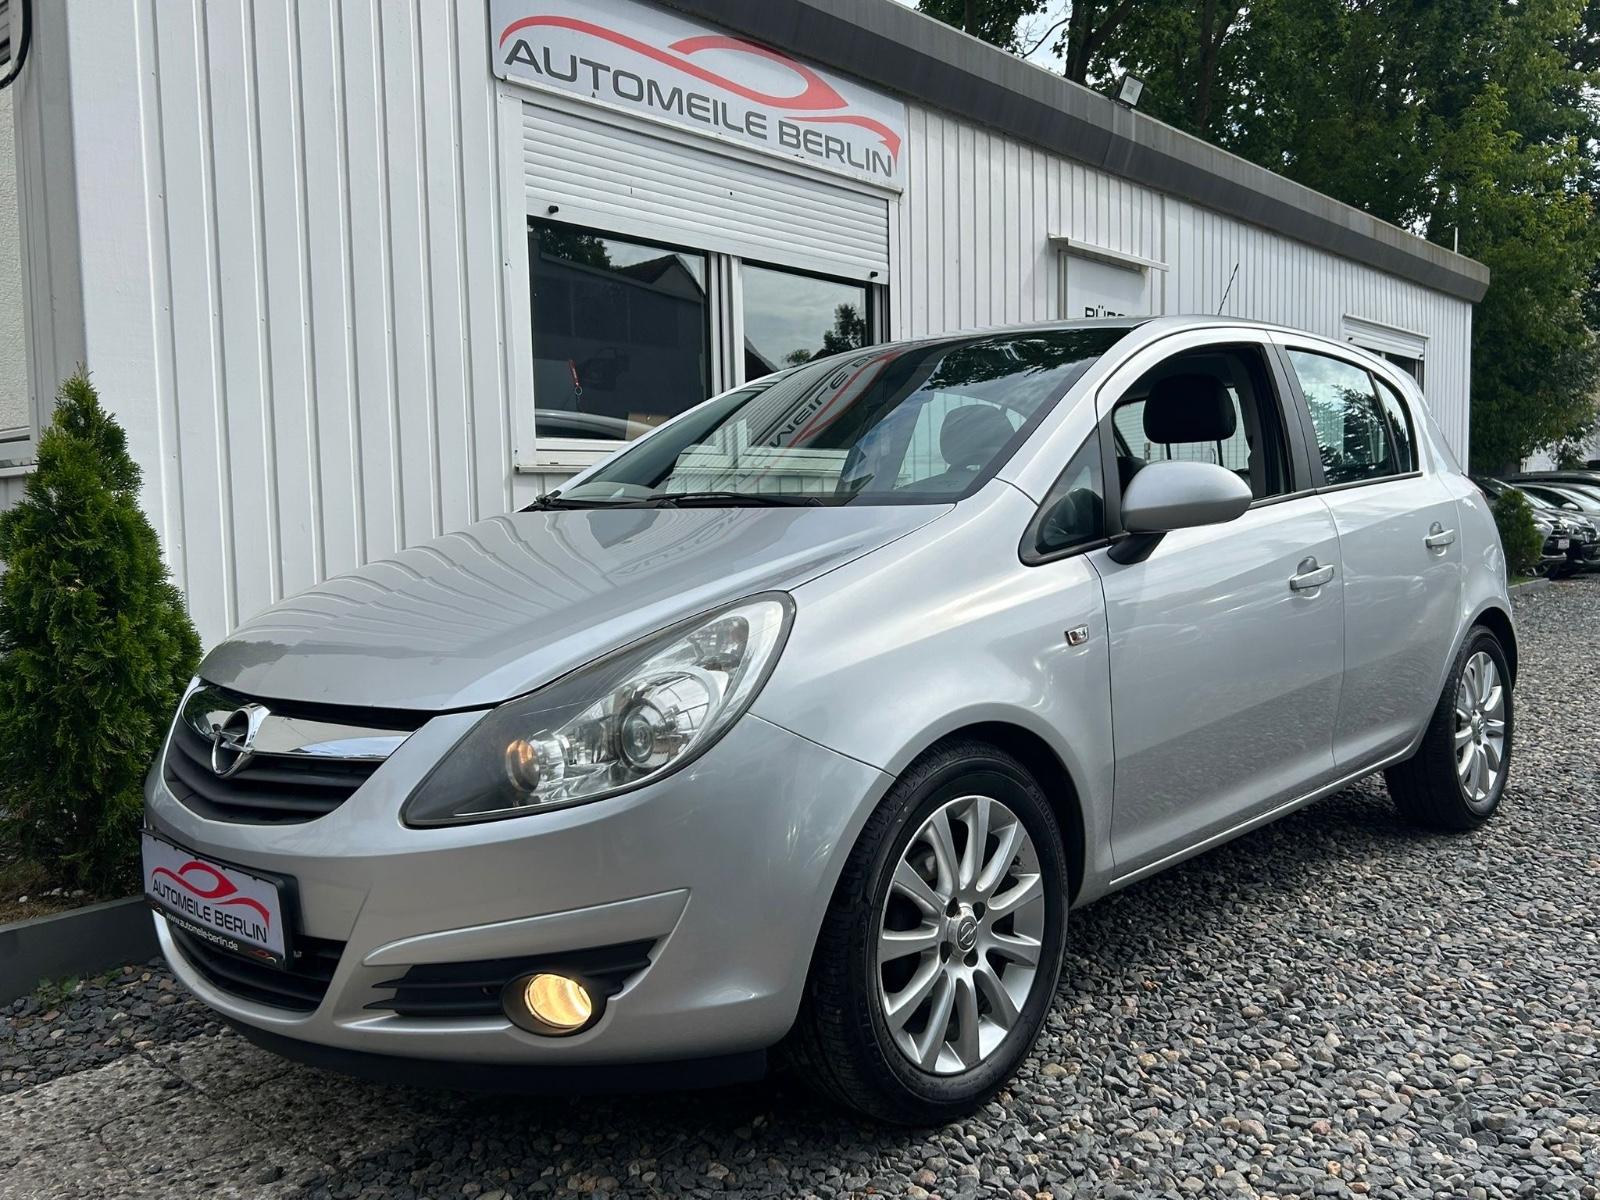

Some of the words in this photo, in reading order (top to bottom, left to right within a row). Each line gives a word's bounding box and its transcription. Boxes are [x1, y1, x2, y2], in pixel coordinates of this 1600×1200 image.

[504, 38, 768, 141] AUTOMEILE
[778, 119, 892, 178] BERLIN
[152, 879, 212, 923] AUTOMEILE
[214, 909, 268, 943] BERLIN
